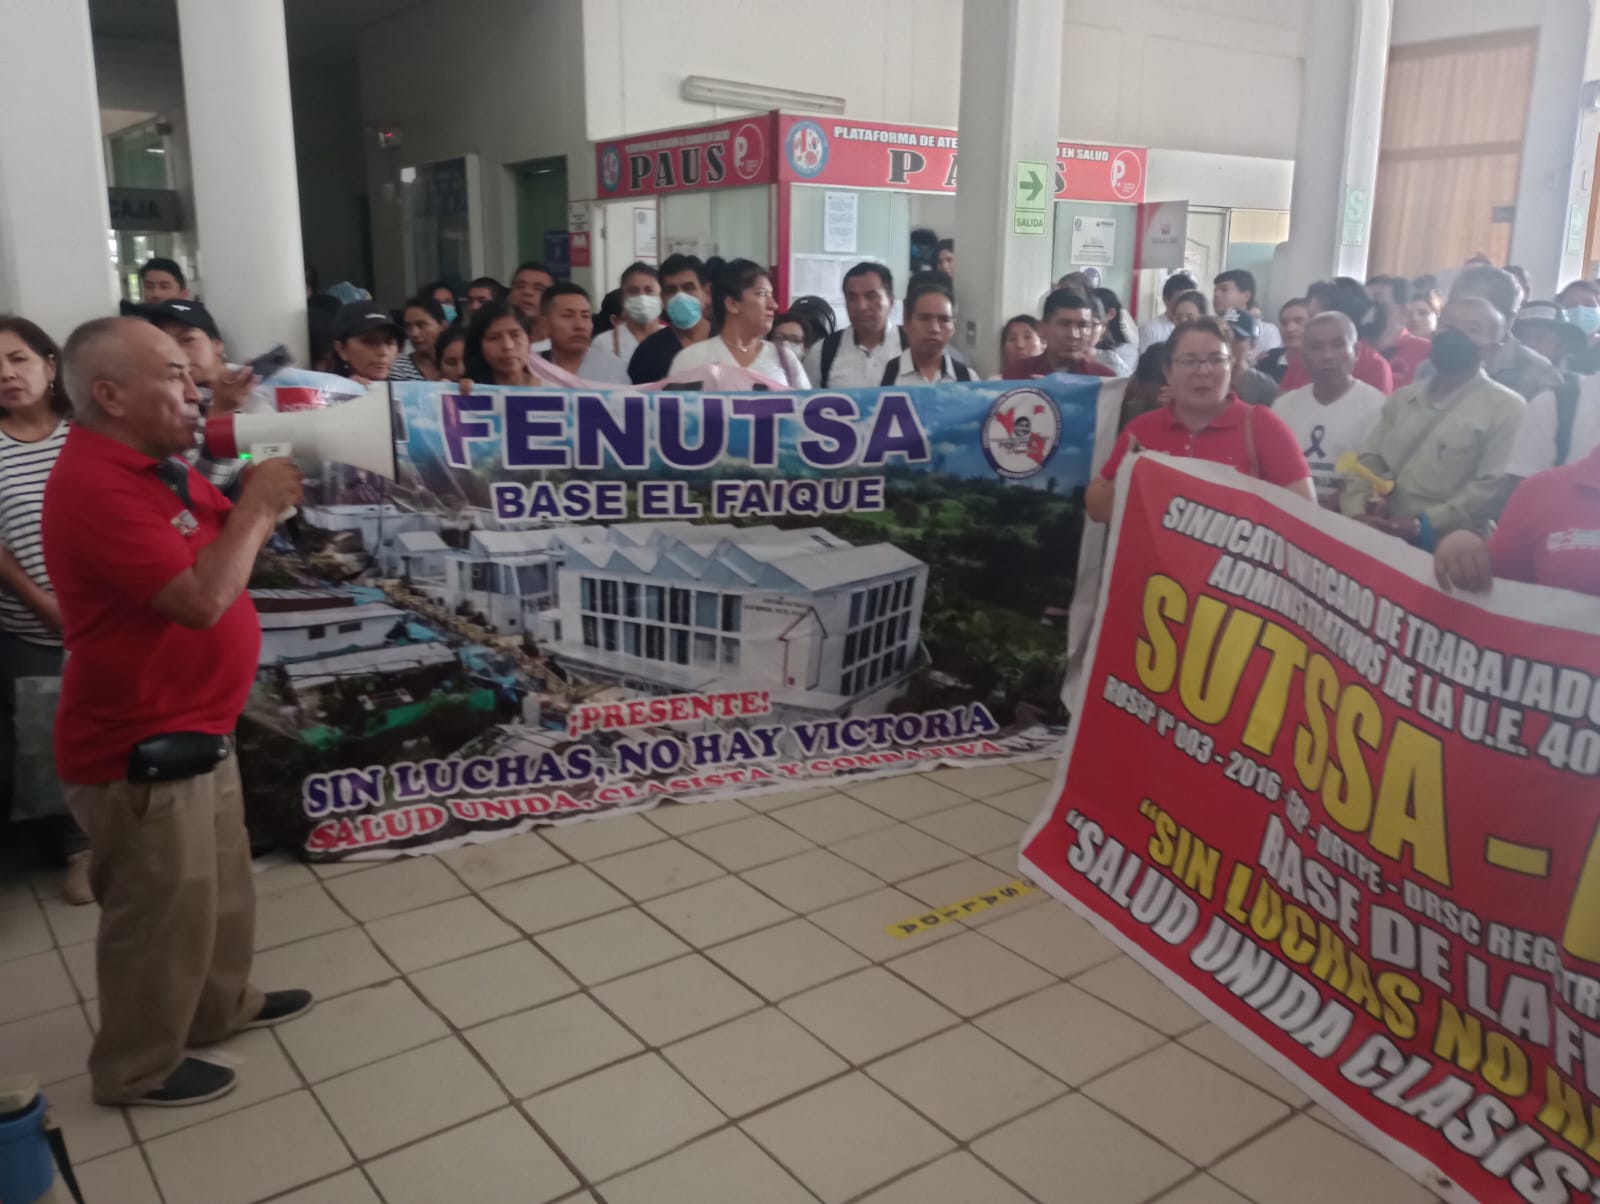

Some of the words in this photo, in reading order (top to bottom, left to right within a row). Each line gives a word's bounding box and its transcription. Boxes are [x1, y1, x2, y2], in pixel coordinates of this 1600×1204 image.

[630, 144, 725, 190] PAUS
[833, 126, 917, 146] PLATAFORMA
[919, 134, 935, 147] DE
[1062, 147, 1075, 158] EN
[1076, 148, 1109, 161] SALUD
[1016, 217, 1043, 228] SALIDA
[438, 392, 931, 469] FENUTSA
[490, 480, 627, 522] BASE
[637, 480, 703, 519] EL
[712, 475, 885, 518] FAIQUE
[1374, 595, 1405, 650] DE
[566, 690, 771, 738] ¡PRESENTE!
[1134, 572, 1452, 889] SUTSSA
[1381, 652, 1417, 710] DE
[1417, 670, 1455, 731] LA
[303, 765, 385, 816] SIN
[391, 745, 608, 801] LUCHAS,
[613, 737, 681, 776] NO
[690, 725, 787, 768] HAY
[793, 702, 1000, 755] VICTORIA
[304, 805, 448, 851] SALUD
[597, 767, 773, 806] CLASISTA
[778, 763, 803, 777] Y
[810, 740, 1006, 773] COMBATIVA
[1223, 750, 1283, 802] 2016
[1402, 878, 1482, 946] DRSC
[898, 886, 1020, 934] SALIDA
[1258, 812, 1361, 946] BASE
[1370, 903, 1452, 993] DE
[1466, 953, 1551, 1048] LA
[1223, 860, 1423, 1041] LUCHAS
[1432, 996, 1530, 1097] NO
[1189, 914, 1356, 1059] UNIDA
[1337, 1032, 1600, 1204] CLASIS
